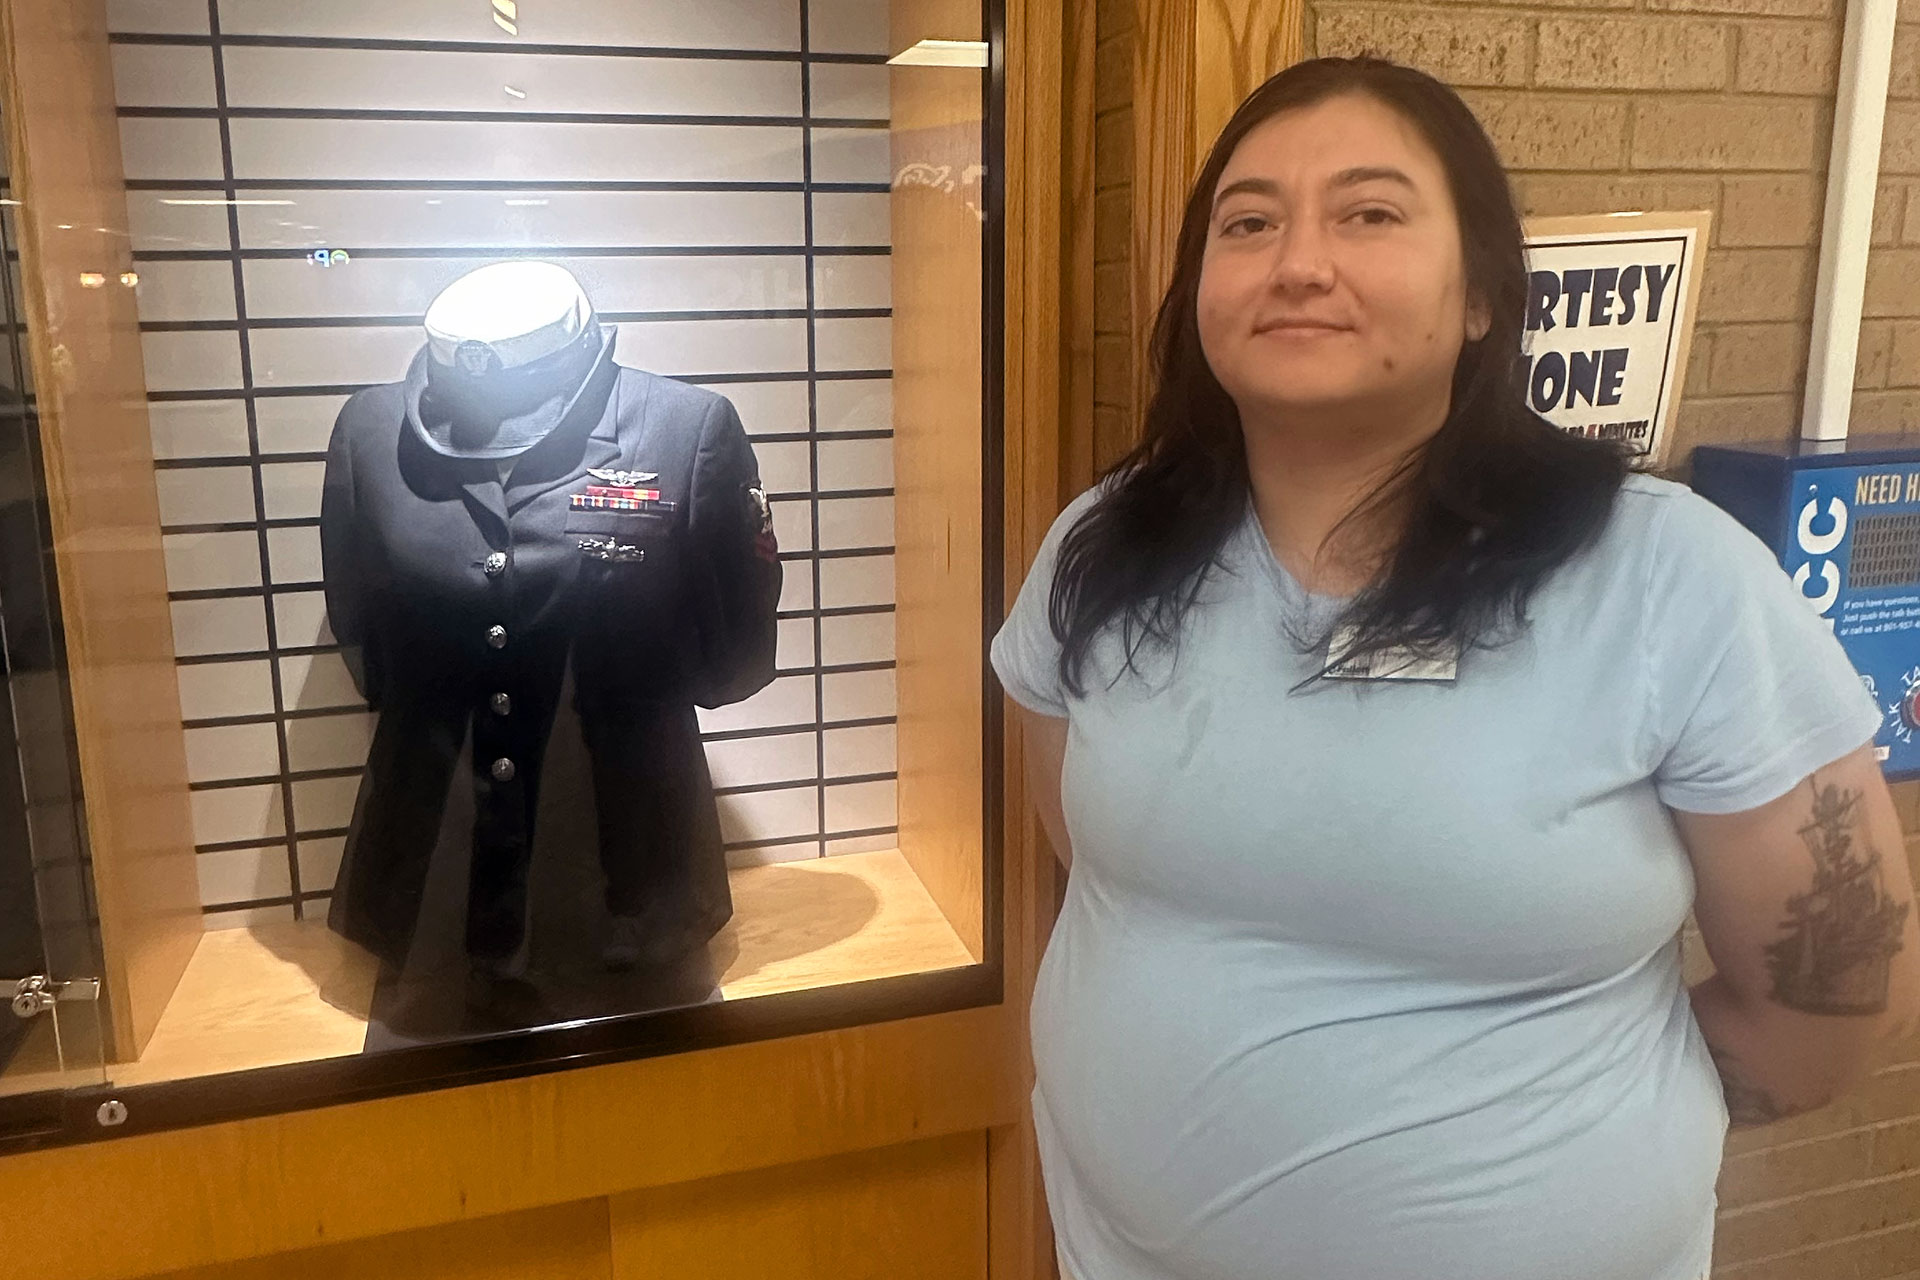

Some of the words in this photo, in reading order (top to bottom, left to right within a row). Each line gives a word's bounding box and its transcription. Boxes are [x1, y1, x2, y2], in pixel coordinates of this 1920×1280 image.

[1526, 264, 1676, 332] RTESY
[1531, 348, 1629, 413] ONE
[1598, 420, 1649, 439] MINUTES
[1855, 474, 1901, 505] NEED
[1905, 473, 1920, 503] H
[1792, 497, 1848, 630] CC
[1879, 611, 1891, 619] the
[1900, 665, 1920, 686] TA
[1887, 701, 1912, 744] TALK
